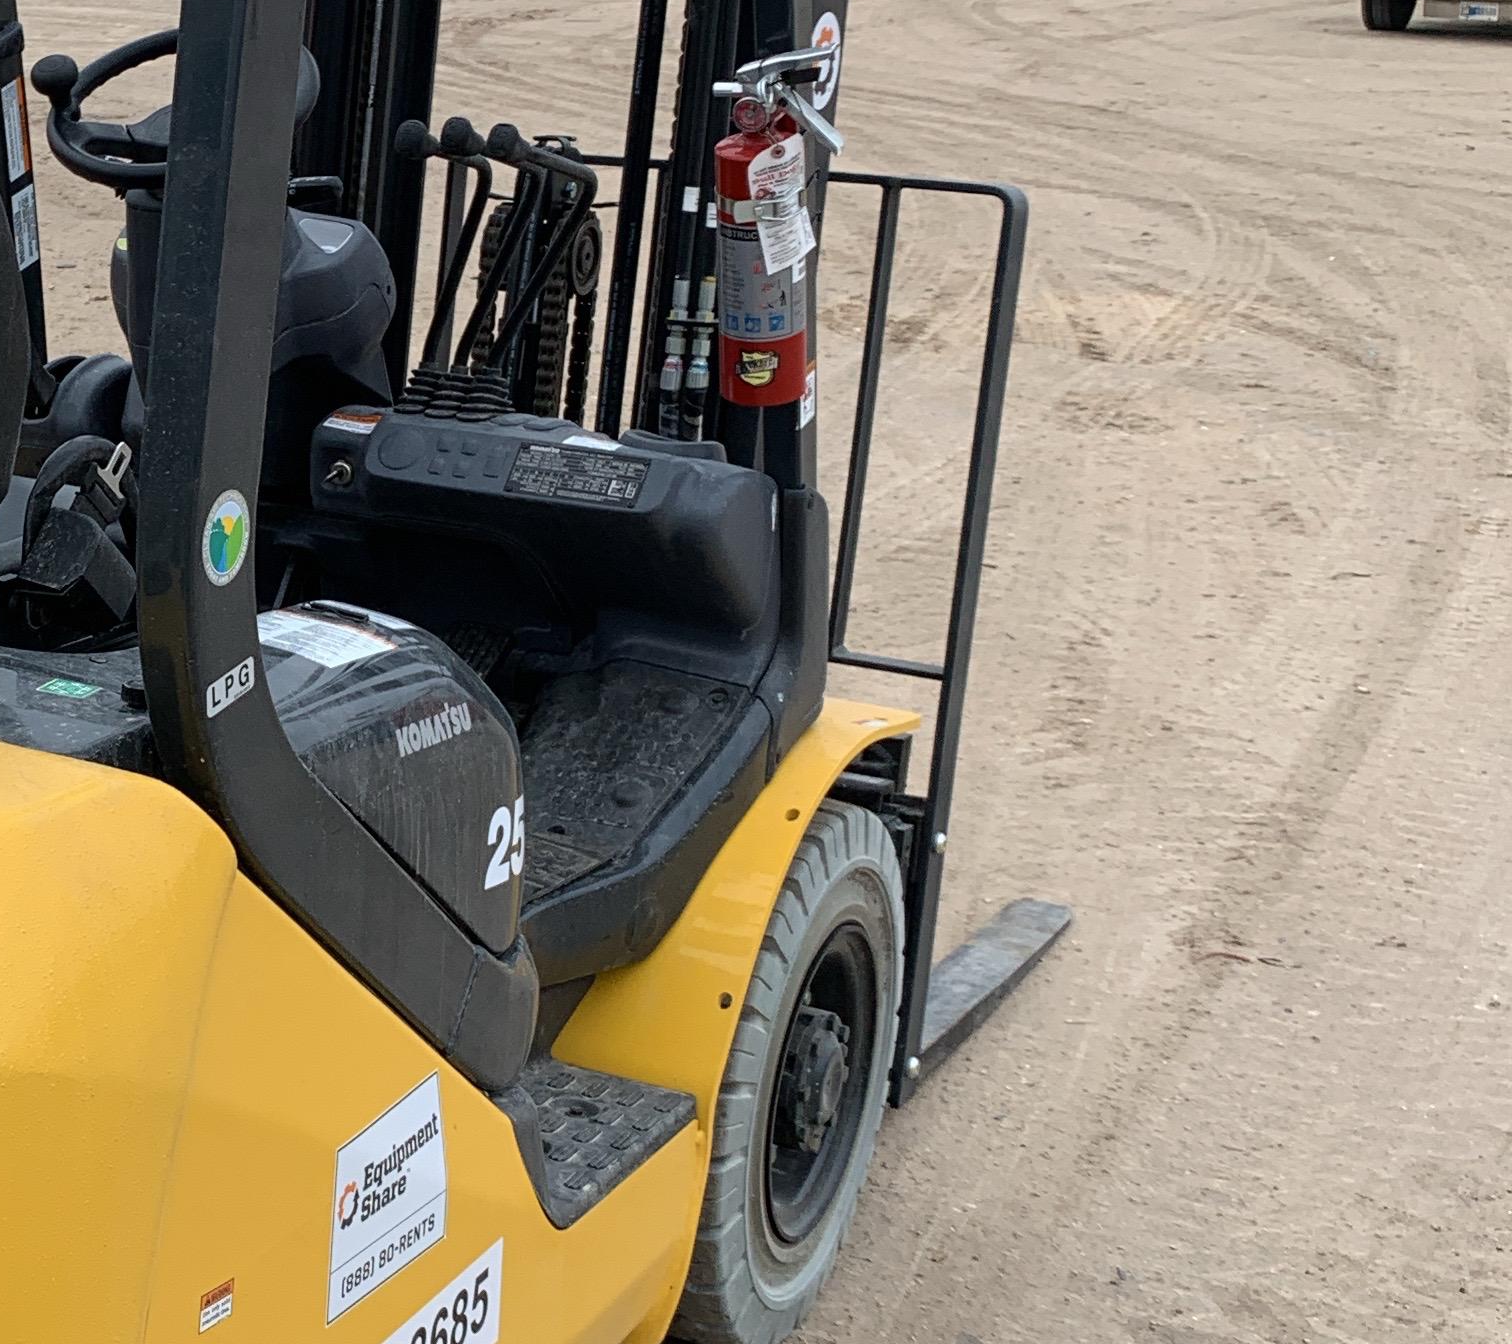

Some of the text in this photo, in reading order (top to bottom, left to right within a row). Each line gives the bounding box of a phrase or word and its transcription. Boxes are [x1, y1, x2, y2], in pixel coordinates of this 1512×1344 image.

[395, 702, 472, 757] KOMATSU
[484, 793, 525, 890] 25
[362, 1112, 439, 1192] Equipment
[360, 1172, 408, 1223] Share
[341, 1212, 436, 1299] (888) 80-RENTS
